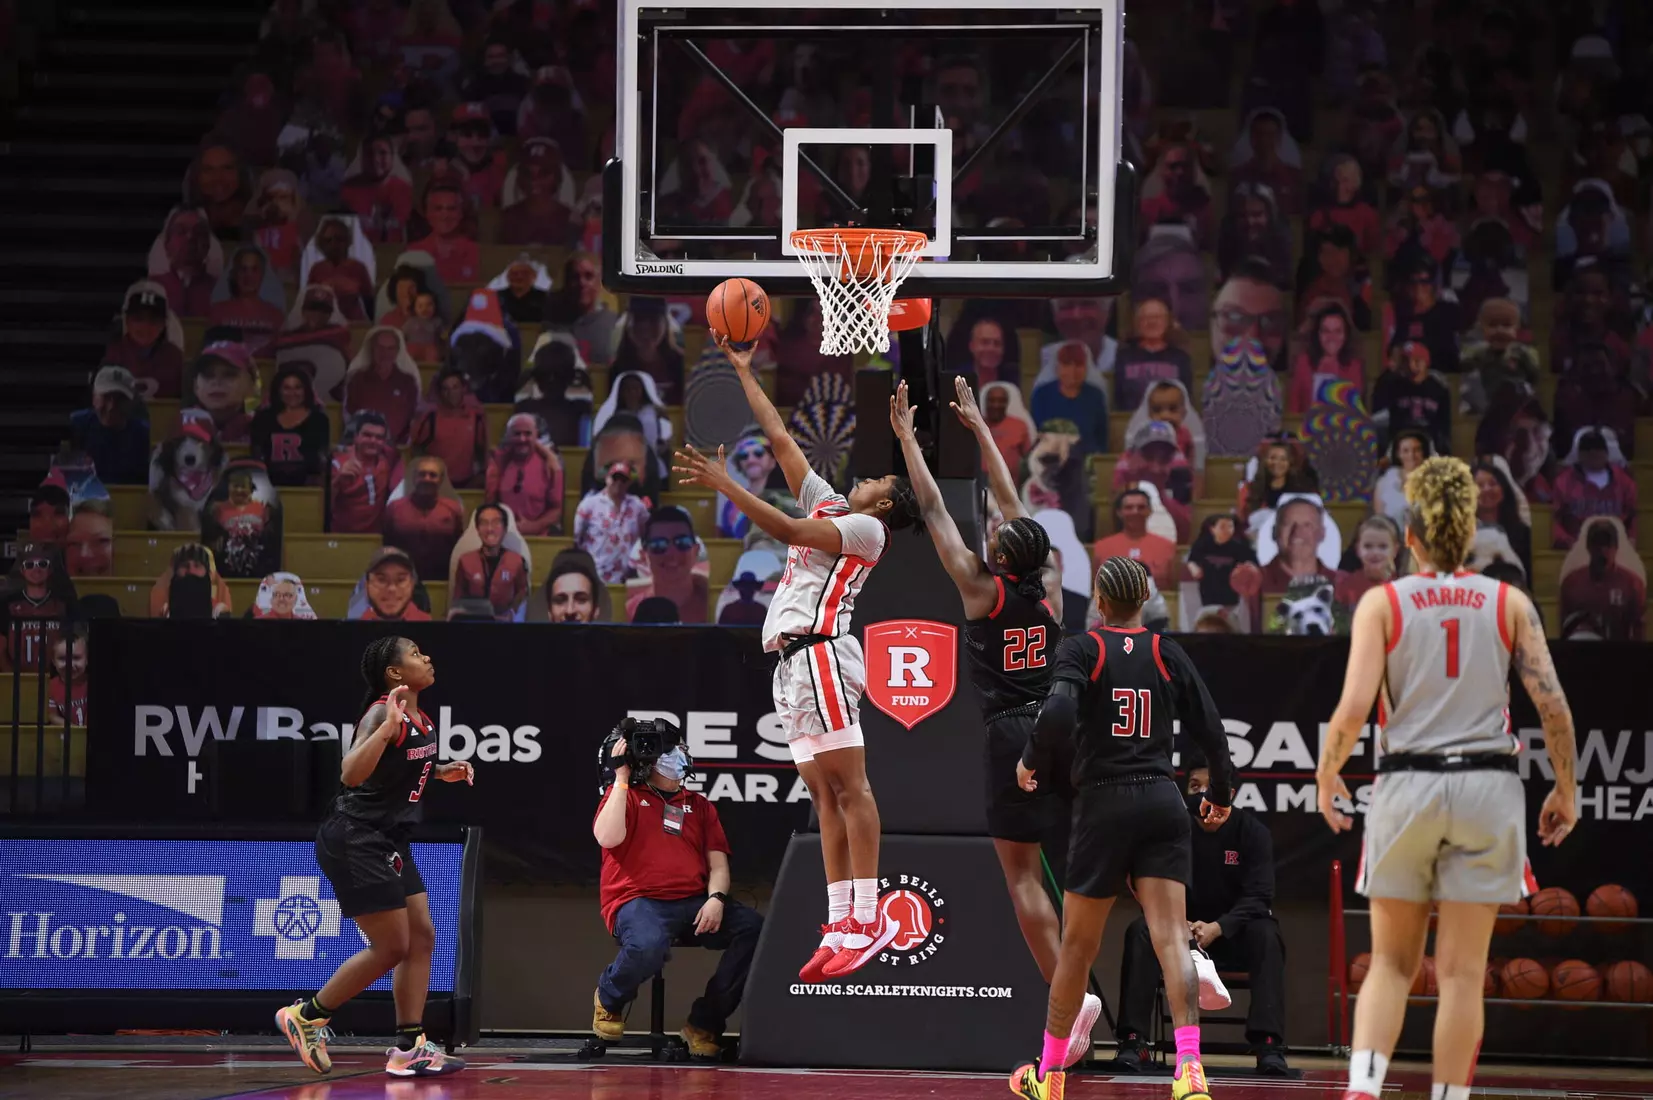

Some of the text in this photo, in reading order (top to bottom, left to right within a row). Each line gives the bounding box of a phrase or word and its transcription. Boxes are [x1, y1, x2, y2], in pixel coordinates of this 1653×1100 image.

[635, 263, 683, 275] SPALDING
[270, 432, 304, 461] R
[1409, 586, 1487, 612] HARRIS
[1003, 624, 1047, 671] 22
[1440, 617, 1461, 679] 1
[886, 645, 933, 688] R
[891, 695, 930, 706] FUND
[1111, 687, 1152, 739] 31
[1220, 718, 1382, 771] SAF
[408, 760, 433, 803] 3
[684, 773, 779, 803] EAR
[682, 804, 693, 814] R
[1232, 781, 1374, 815] A MAS
[1224, 849, 1240, 865] R
[899, 874, 944, 907] BELLS
[3, 911, 223, 959] Horizon
[908, 934, 945, 966] RING
[789, 984, 1013, 999] GIVING.SCARLETKNIGHTS.COM
